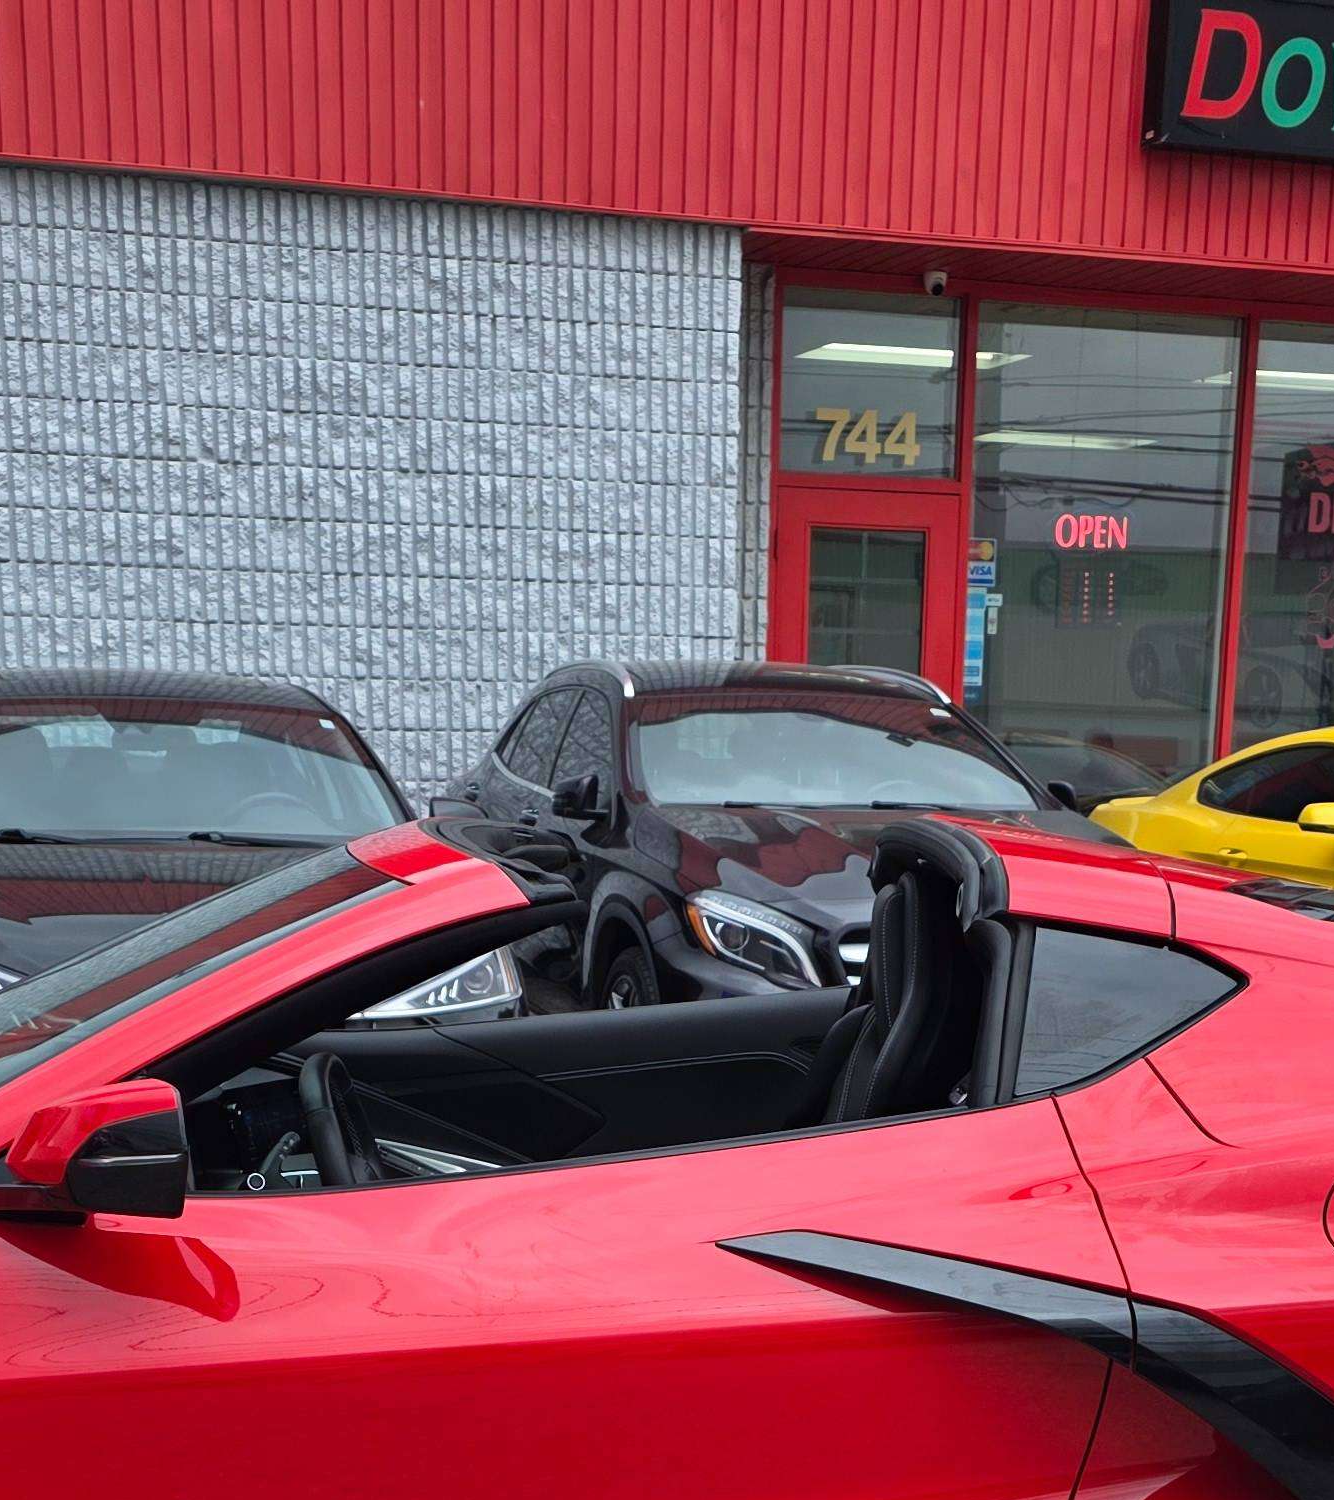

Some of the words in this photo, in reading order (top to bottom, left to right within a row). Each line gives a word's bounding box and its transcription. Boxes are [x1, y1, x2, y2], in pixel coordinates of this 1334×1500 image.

[816, 408, 920, 466] 744
[1055, 513, 1128, 550] OPEN
[970, 565, 993, 576] VISA
